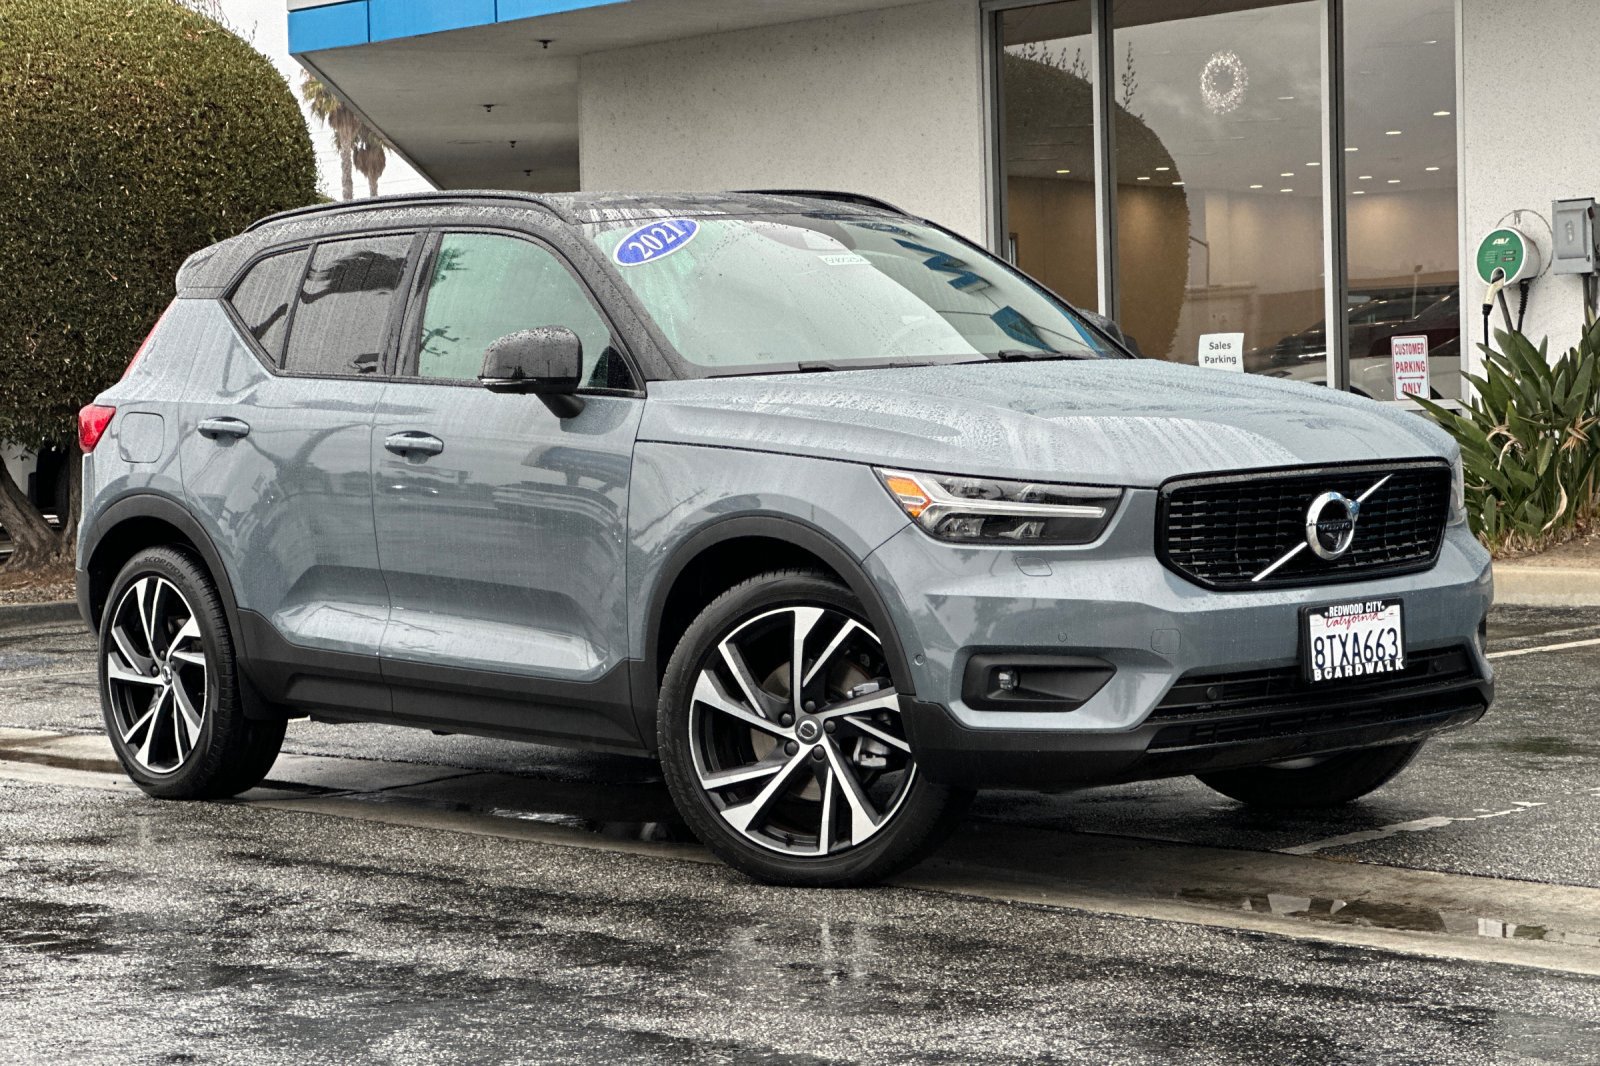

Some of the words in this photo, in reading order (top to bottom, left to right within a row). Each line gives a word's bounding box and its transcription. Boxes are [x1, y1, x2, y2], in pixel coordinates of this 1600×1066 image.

[629, 222, 686, 259] 2021
[1209, 342, 1232, 350] Sales
[1395, 343, 1425, 355] CUSTOMER
[1204, 355, 1237, 364] Parking
[1395, 361, 1426, 373] PARKING
[1402, 382, 1422, 394] ONLY
[144, 556, 186, 580] SCORPION
[1329, 603, 1364, 617] REDWOOD
[1366, 601, 1382, 613] CITY
[1326, 612, 1384, 630] California
[1314, 628, 1399, 669] 8TXA663
[1314, 658, 1405, 681] BOARDWALK
